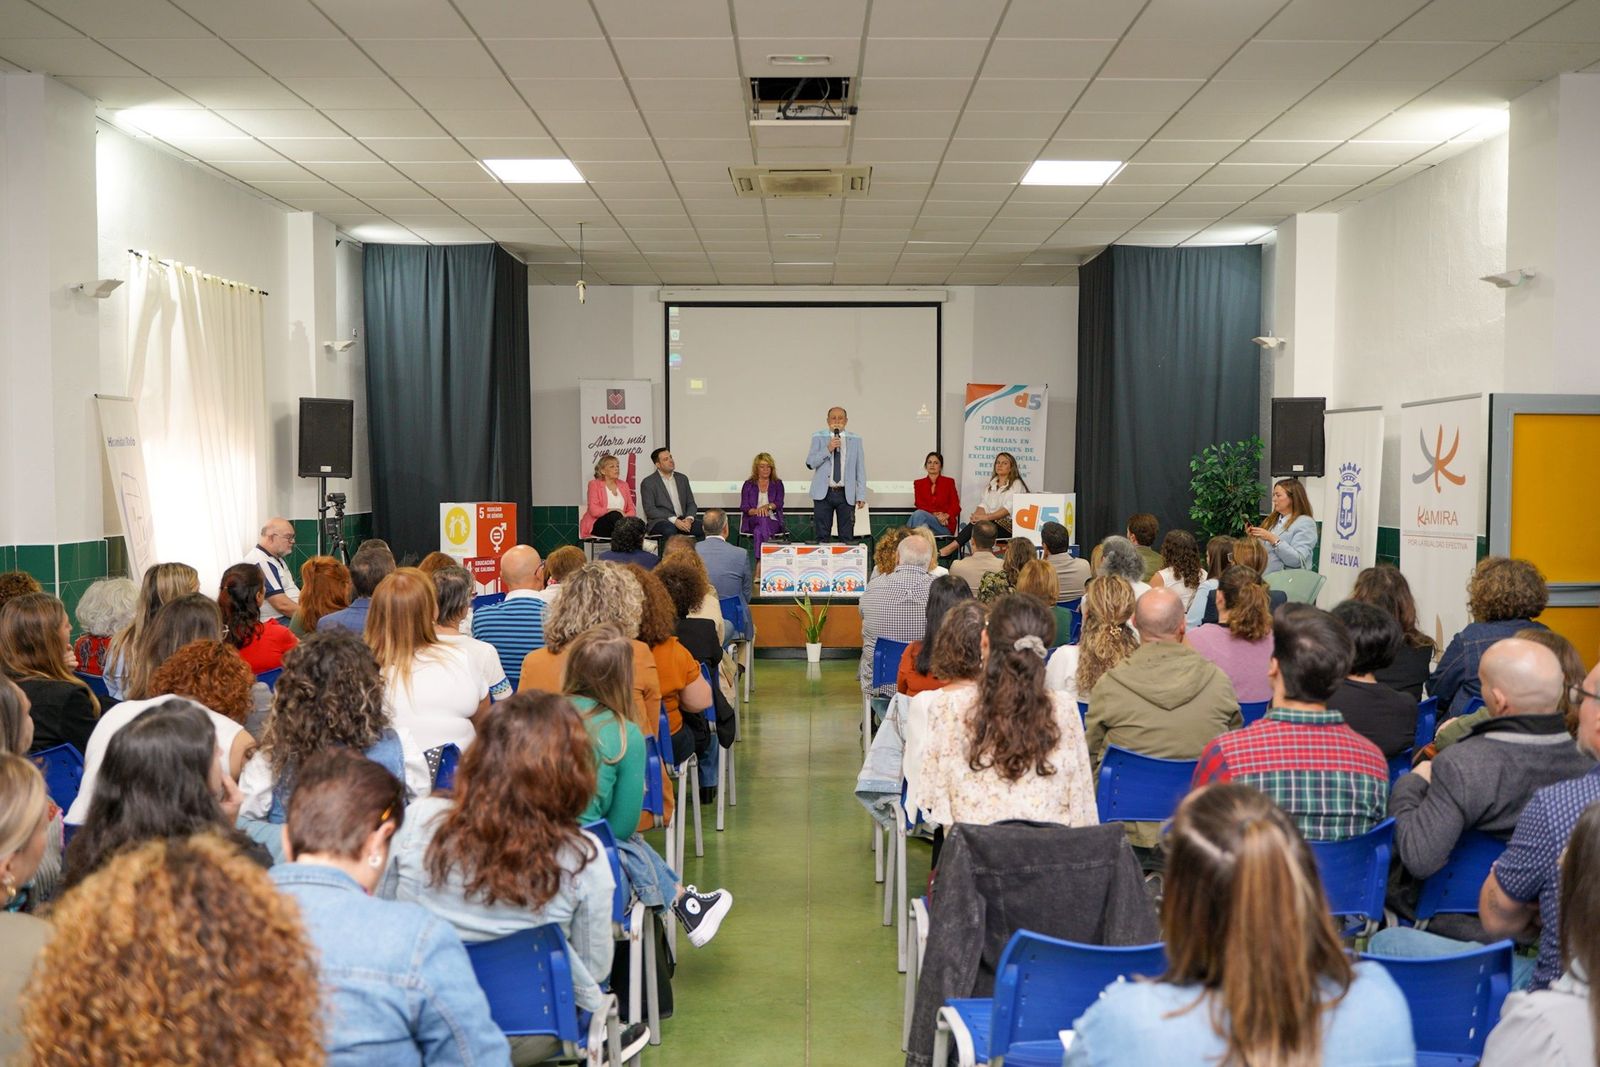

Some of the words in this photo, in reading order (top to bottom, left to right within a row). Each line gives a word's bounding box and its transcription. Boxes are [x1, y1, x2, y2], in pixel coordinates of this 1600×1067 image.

[592, 413, 641, 424] valdocco
[981, 416, 1031, 425] JORNADAS
[588, 435, 624, 449] Ahora
[627, 434, 646, 444] más
[592, 449, 611, 464] que
[613, 447, 642, 456] nunca
[479, 507, 485, 519] 5
[1417, 506, 1459, 527] KAMIRA
[1331, 552, 1359, 567] HUELVA
[467, 561, 472, 573] 4
